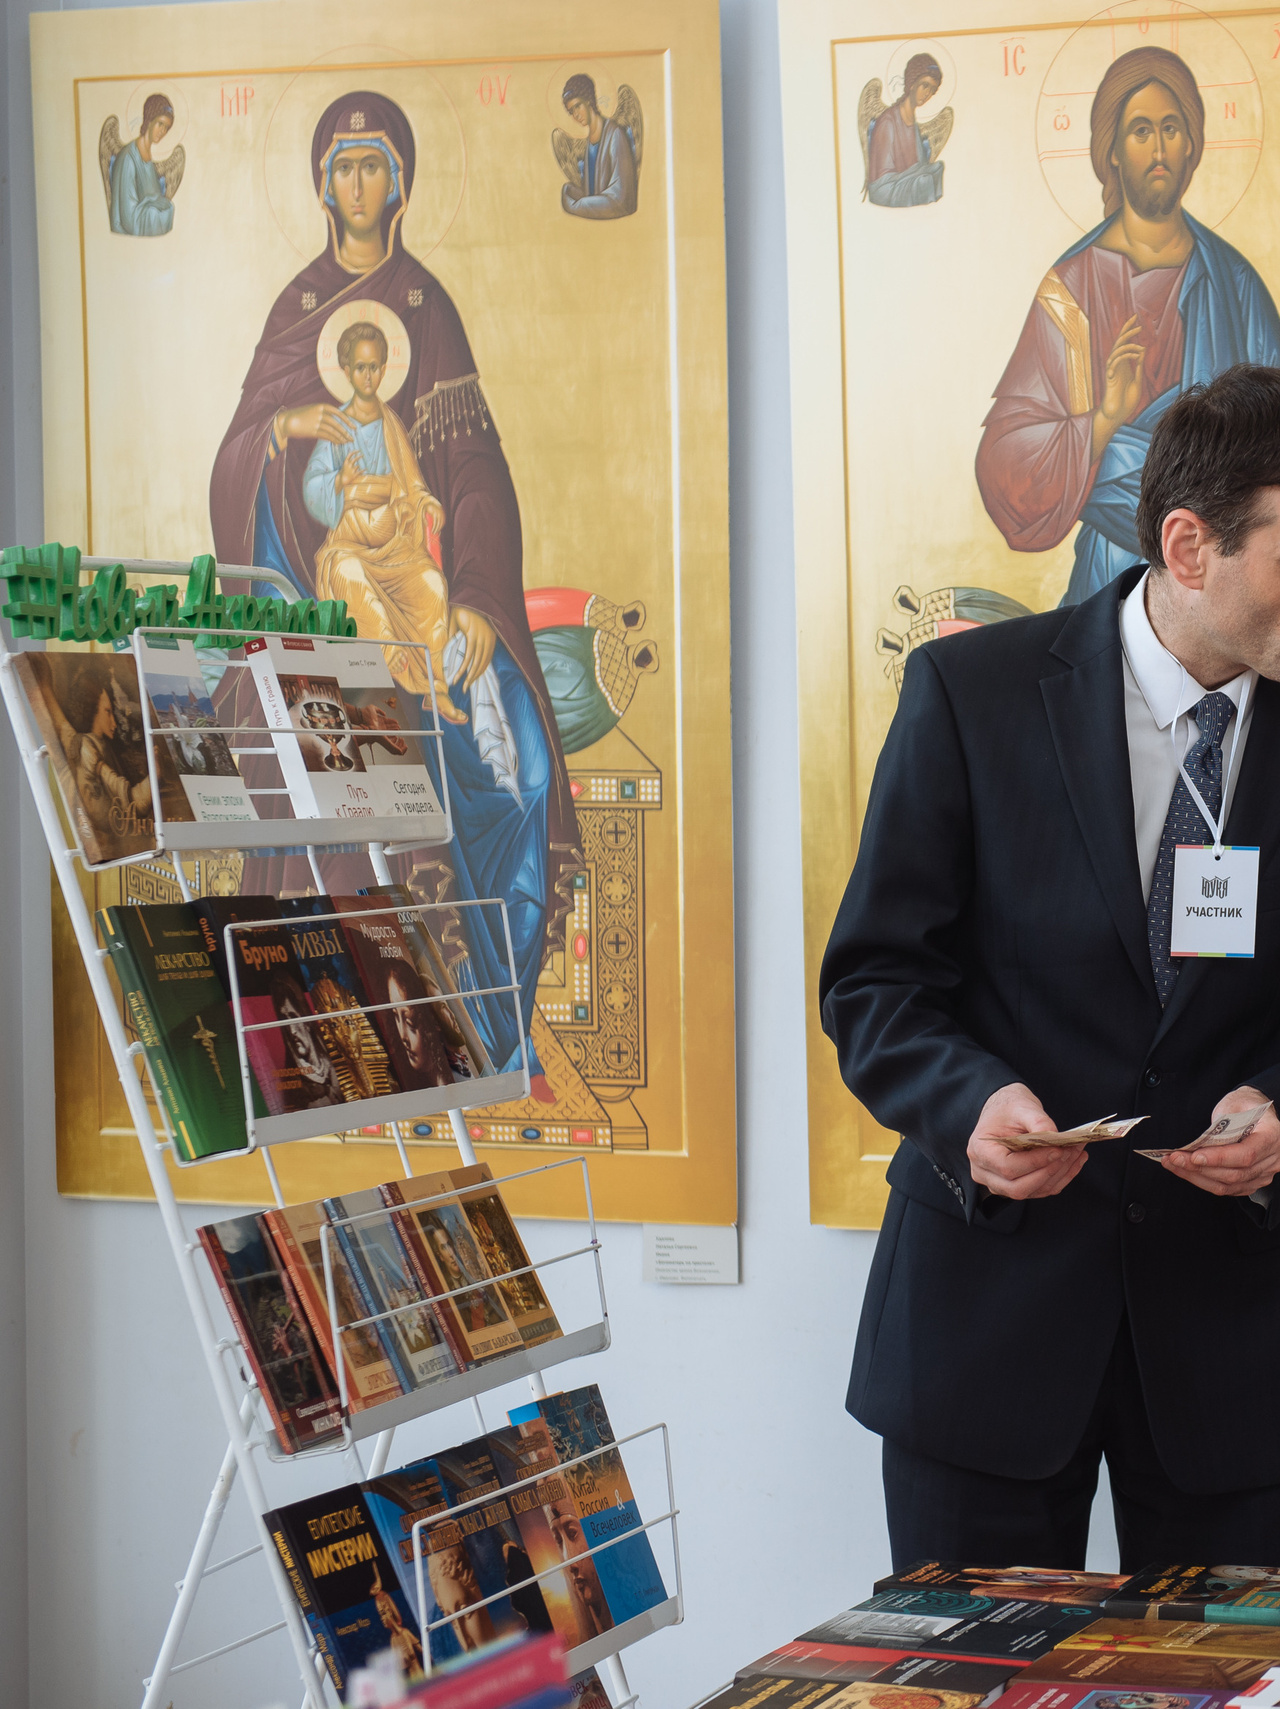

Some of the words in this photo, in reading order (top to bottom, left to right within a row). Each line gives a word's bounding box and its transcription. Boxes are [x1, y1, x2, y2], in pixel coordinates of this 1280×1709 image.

[270, 708, 283, 727] Путь
[346, 784, 369, 803] Путь
[393, 780, 427, 795] Сегодня
[394, 803, 401, 813] я
[1185, 906, 1243, 919] УЧАСТНИК
[199, 917, 217, 953] Бруно
[360, 923, 397, 942] Мудрость
[238, 939, 289, 971] Бруно
[291, 928, 345, 960] ИВЫ
[378, 943, 404, 959] любви
[155, 951, 211, 971] ЛЕКАРСТВО
[570, 1479, 600, 1500] Китай,
[614, 1488, 626, 1511] &
[579, 1496, 611, 1518] Россия
[306, 1504, 366, 1541] ЕГИПЕТСКИЕ
[589, 1510, 637, 1539] Всечеловек
[272, 1530, 295, 1569] МИСТЕРИИ
[305, 1531, 379, 1579] МИСТЕРИИ
[324, 1653, 344, 1691] Александр
